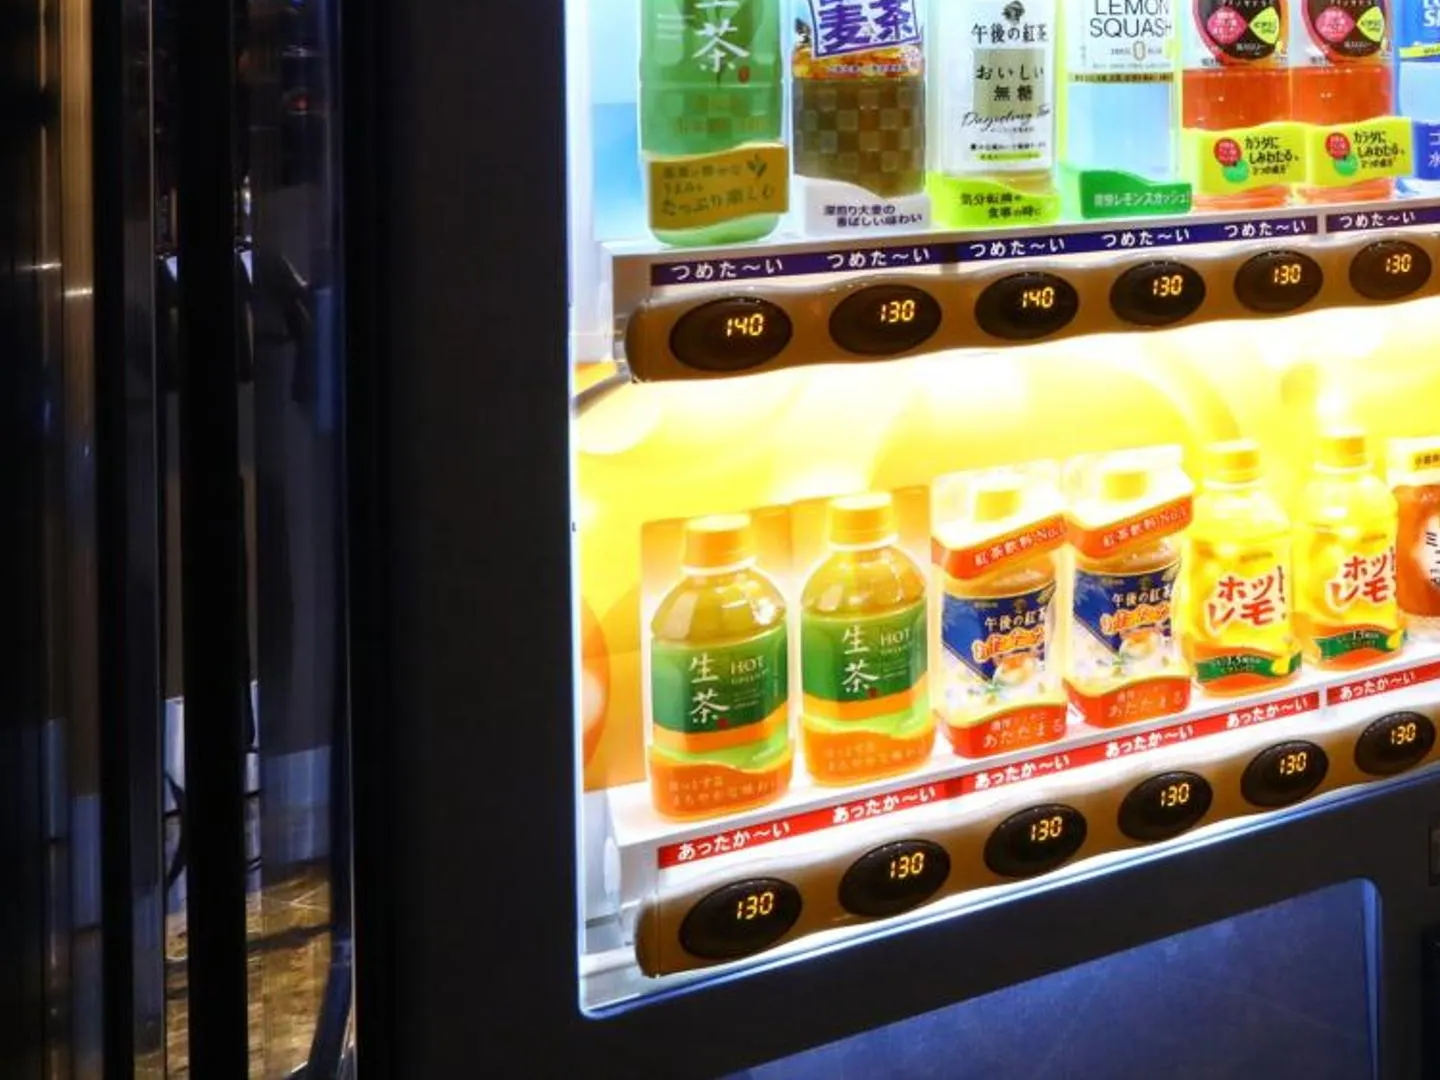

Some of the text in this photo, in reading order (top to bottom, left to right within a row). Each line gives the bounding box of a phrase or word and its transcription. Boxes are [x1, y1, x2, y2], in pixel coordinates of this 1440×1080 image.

[976, 64, 1045, 81] おいしい
[993, 85, 1033, 102] 無糖
[1273, 264, 1301, 285] 130
[1385, 254, 1411, 274] 130
[1022, 286, 1054, 308] 140
[1152, 275, 1183, 296] 130
[880, 300, 915, 323] 130
[725, 313, 764, 337] 140
[881, 629, 911, 647] HOT
[731, 655, 764, 675] HOT
[842, 625, 878, 693] 生茶
[690, 652, 729, 724] 生茶
[1390, 722, 1417, 745] 130
[1279, 752, 1307, 775] 130
[1160, 783, 1190, 808] 130
[1030, 816, 1063, 842] 130
[889, 852, 925, 880] 130
[736, 892, 774, 921] 130
